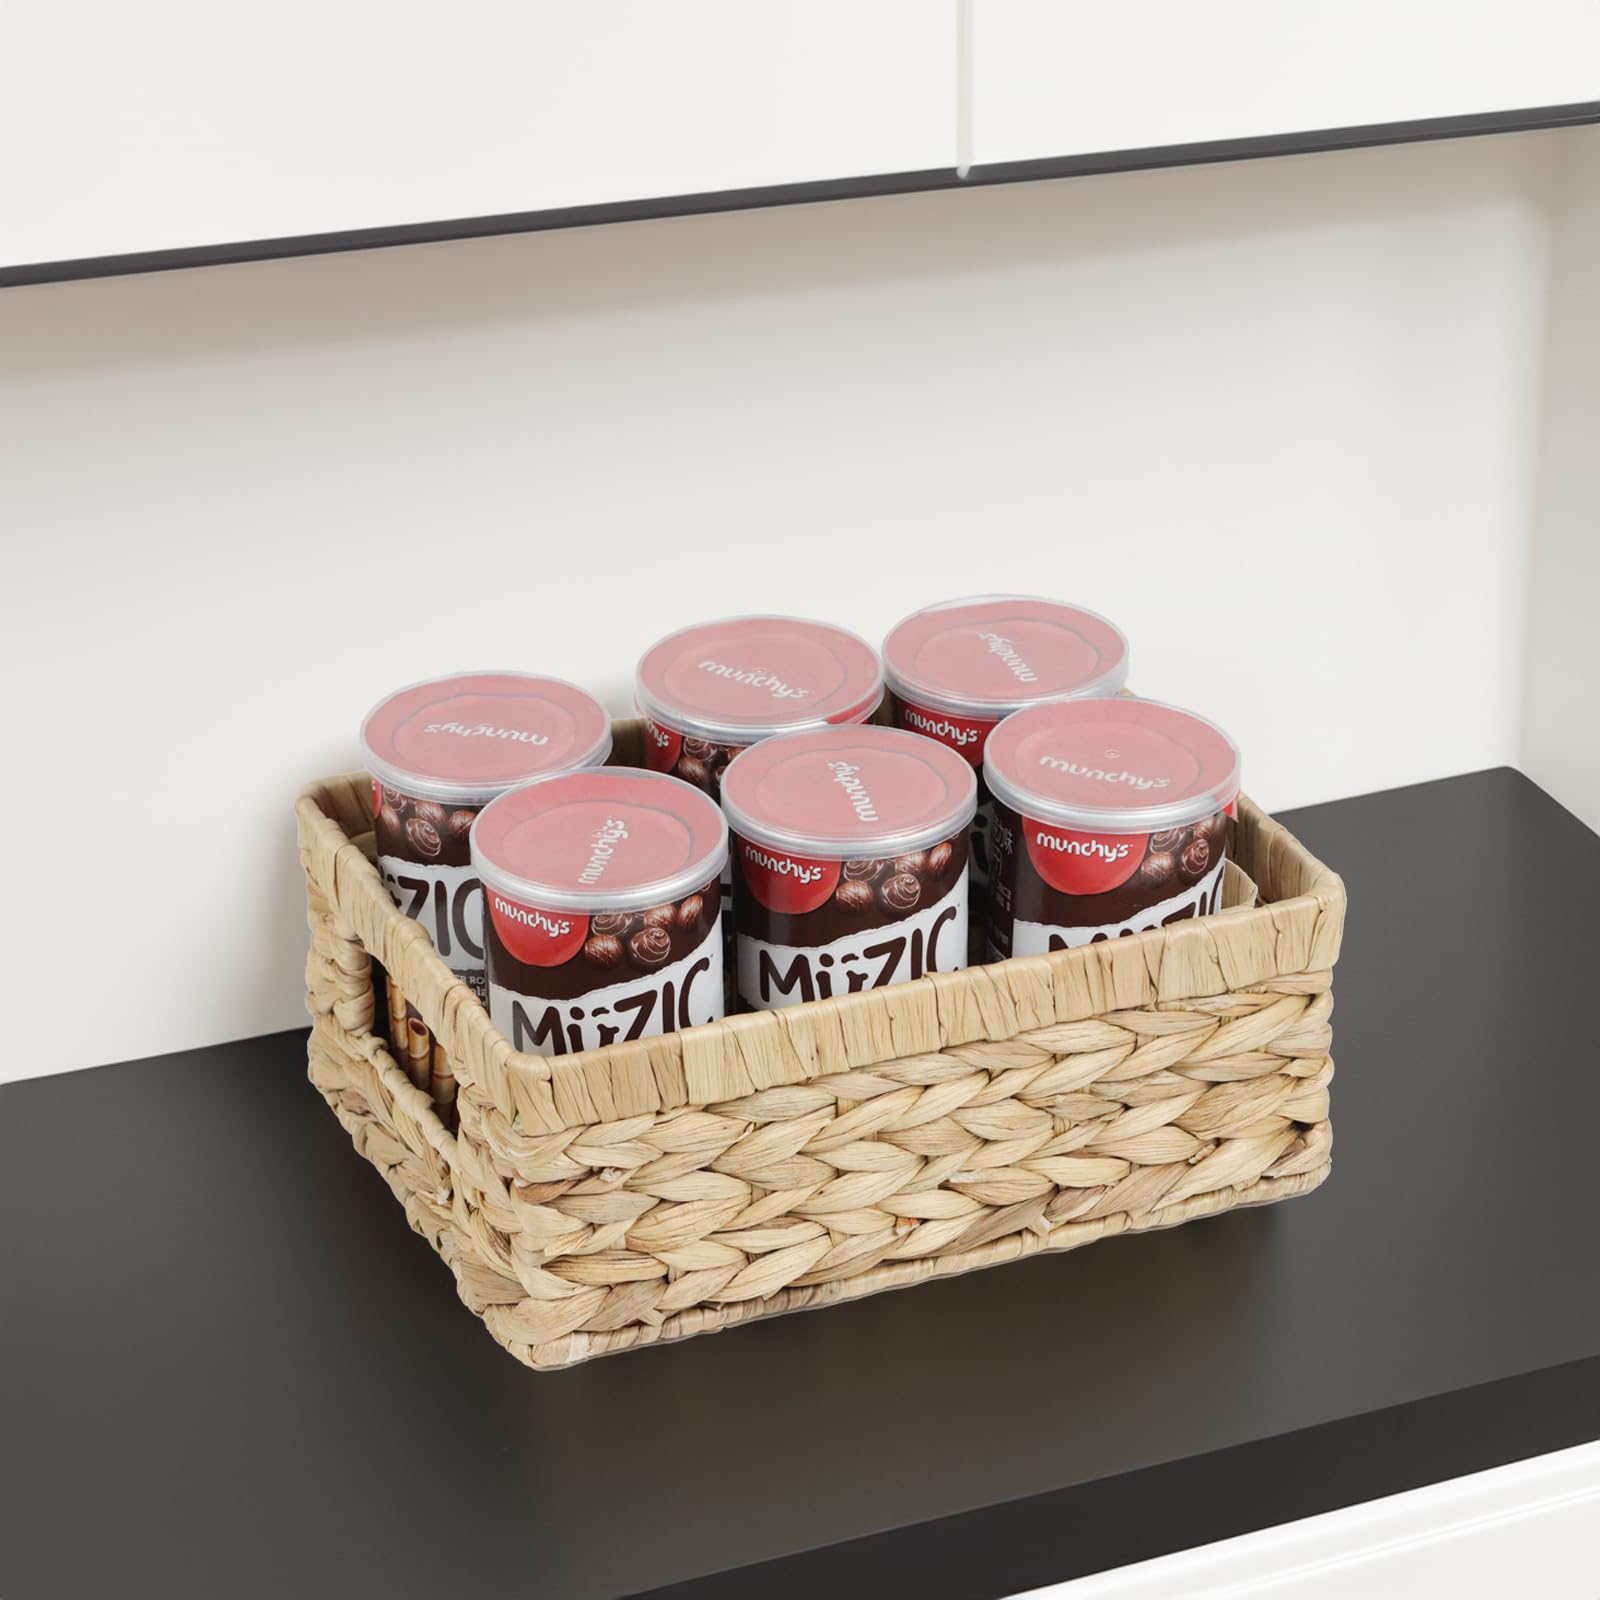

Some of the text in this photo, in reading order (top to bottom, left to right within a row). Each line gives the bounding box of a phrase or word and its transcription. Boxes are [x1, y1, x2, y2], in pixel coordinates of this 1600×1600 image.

[979, 632, 1038, 683] munchy's
[698, 660, 808, 699] munchy's
[424, 722, 548, 746] munchy's
[905, 709, 978, 746] munchy's
[829, 761, 879, 822] munchy's
[1040, 756, 1170, 790] munchy's
[578, 816, 629, 885] munchy's
[745, 846, 823, 884] munchy's
[1036, 832, 1130, 863] munchy's
[495, 897, 571, 938] munchy's
